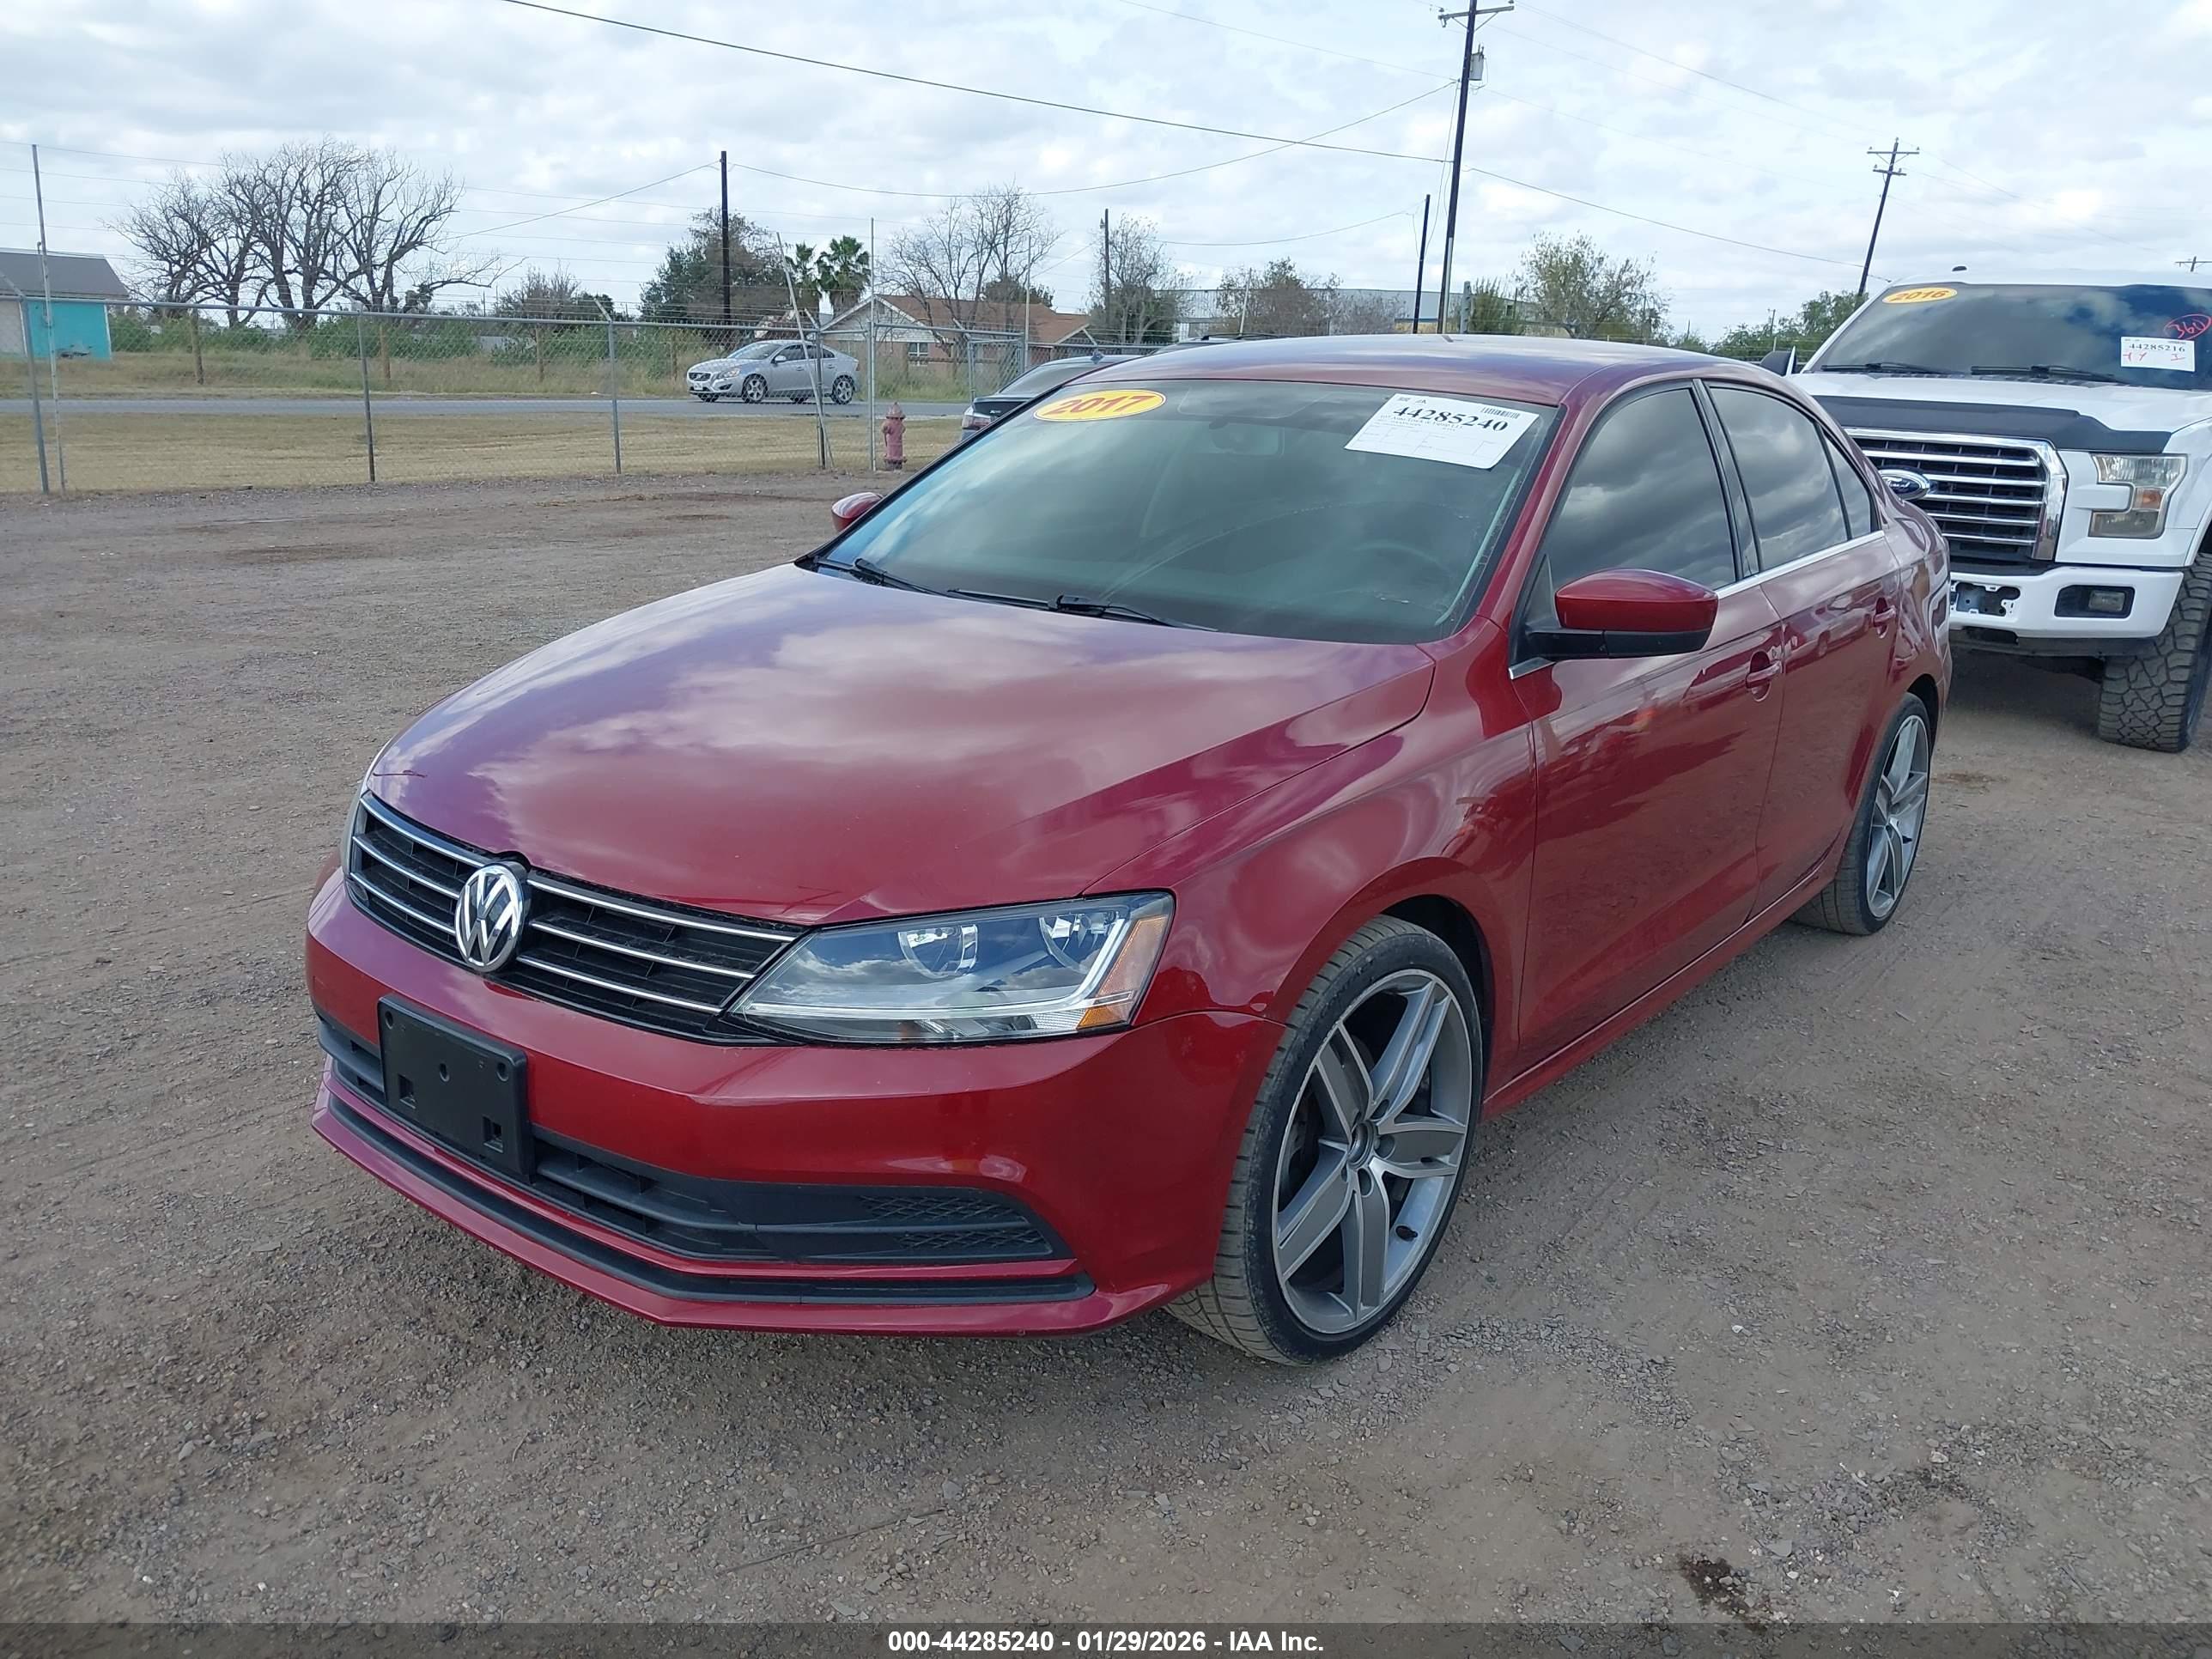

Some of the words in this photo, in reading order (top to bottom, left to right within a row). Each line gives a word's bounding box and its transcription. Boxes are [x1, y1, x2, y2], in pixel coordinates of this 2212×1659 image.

[1890, 290, 1949, 301] 2016
[2129, 343, 2185, 352] 44285216
[1042, 395, 1157, 416] 2017
[1394, 406, 1509, 431] 44285240
